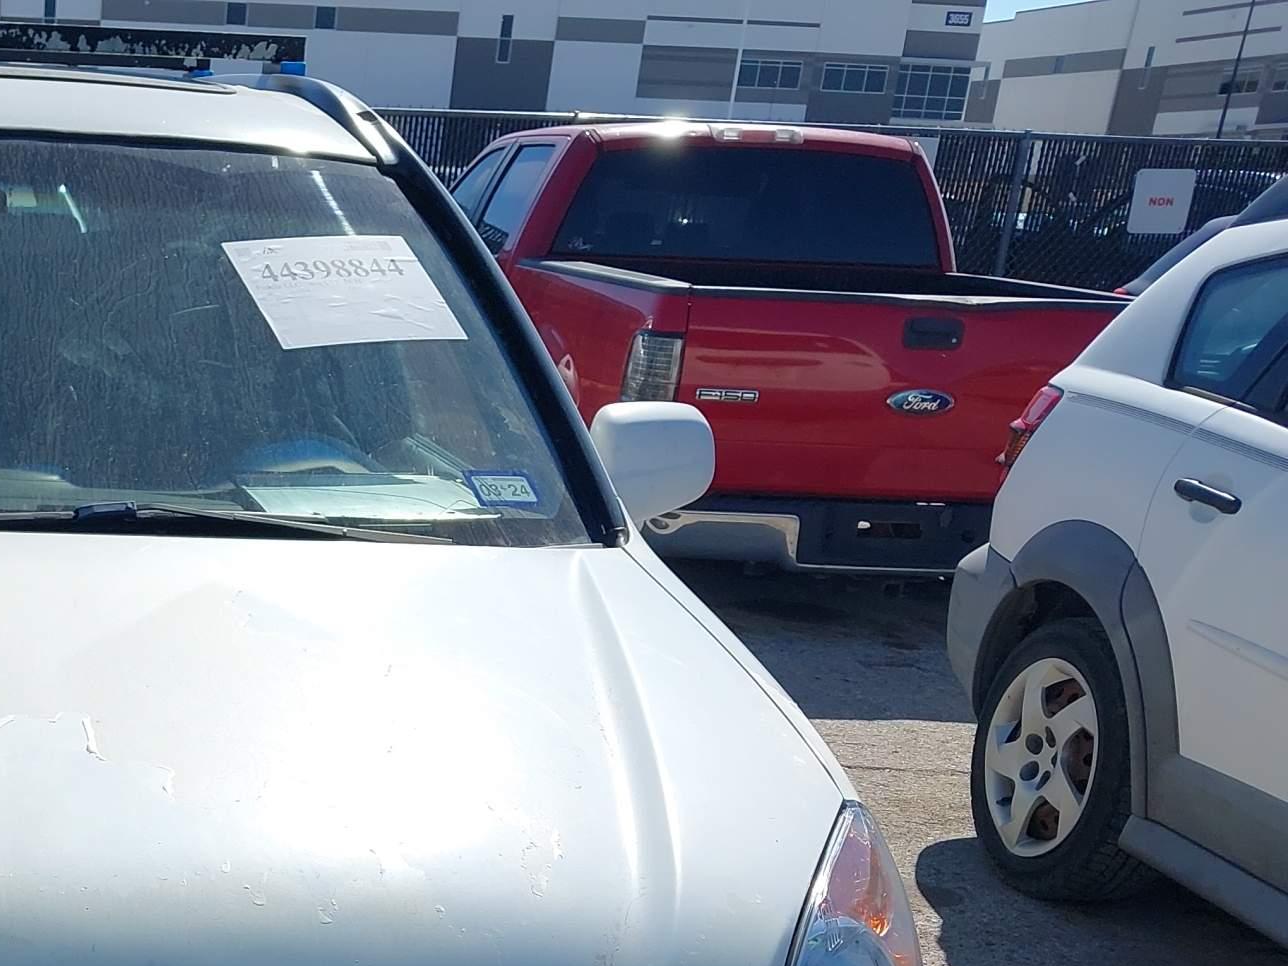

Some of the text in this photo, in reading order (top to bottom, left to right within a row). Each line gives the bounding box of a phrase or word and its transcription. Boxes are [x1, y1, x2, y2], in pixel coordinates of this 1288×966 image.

[1148, 196, 1175, 207] NON
[261, 258, 405, 282] 44398844
[903, 394, 939, 411] Ford
